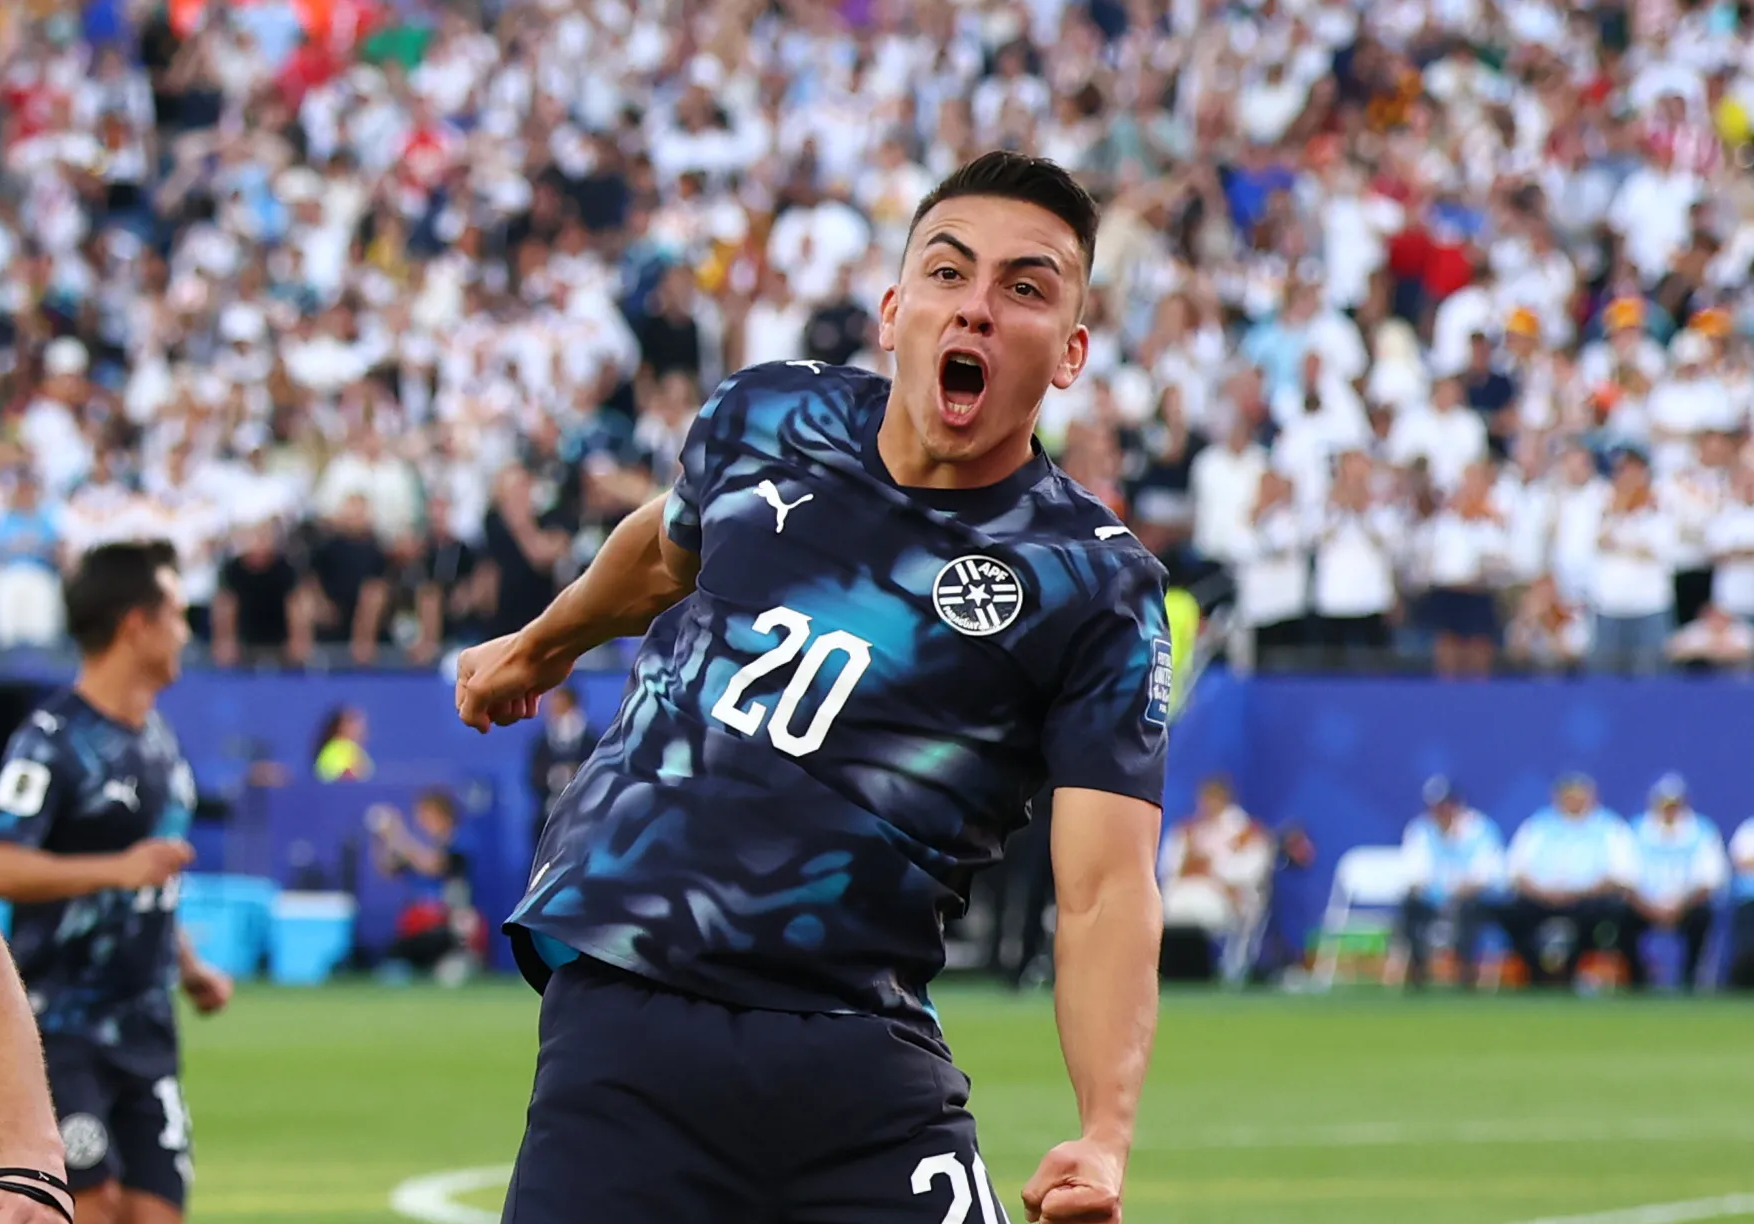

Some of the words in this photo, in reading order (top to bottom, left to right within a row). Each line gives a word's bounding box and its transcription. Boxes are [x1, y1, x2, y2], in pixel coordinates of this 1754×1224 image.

[978, 561, 1009, 582] APF
[942, 605, 981, 631] PARAGUAY
[710, 605, 874, 758] 20
